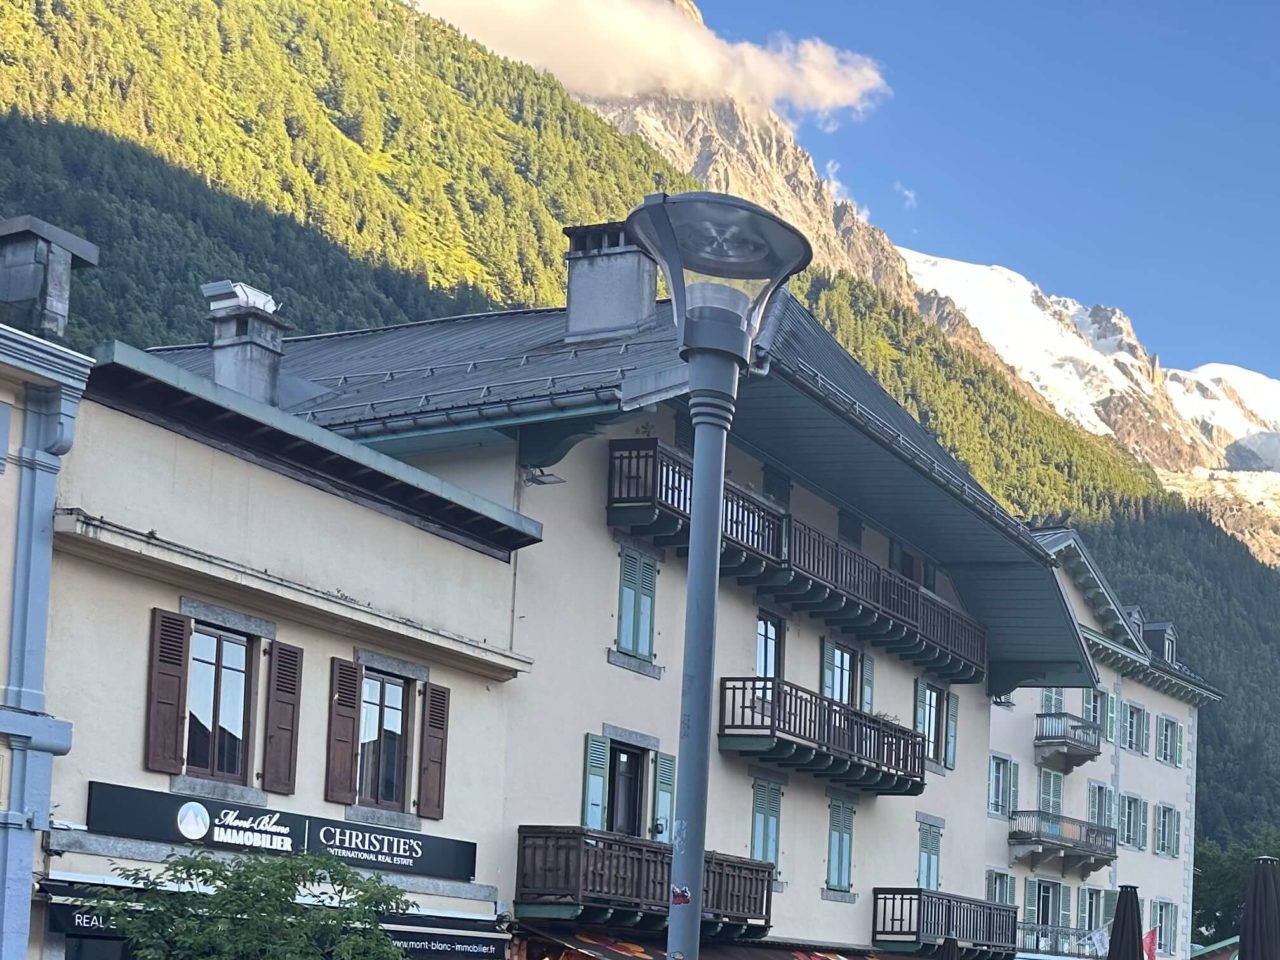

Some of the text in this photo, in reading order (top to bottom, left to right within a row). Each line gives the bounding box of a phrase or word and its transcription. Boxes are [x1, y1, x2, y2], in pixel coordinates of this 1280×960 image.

[214, 809, 290, 834] Mont-Blanc
[213, 826, 293, 852] IMMOBILIER
[319, 826, 423, 858] CHRISTIE'S
[378, 855, 392, 864] REAL
[393, 858, 414, 866] ESTATE
[75, 914, 104, 928] REAL
